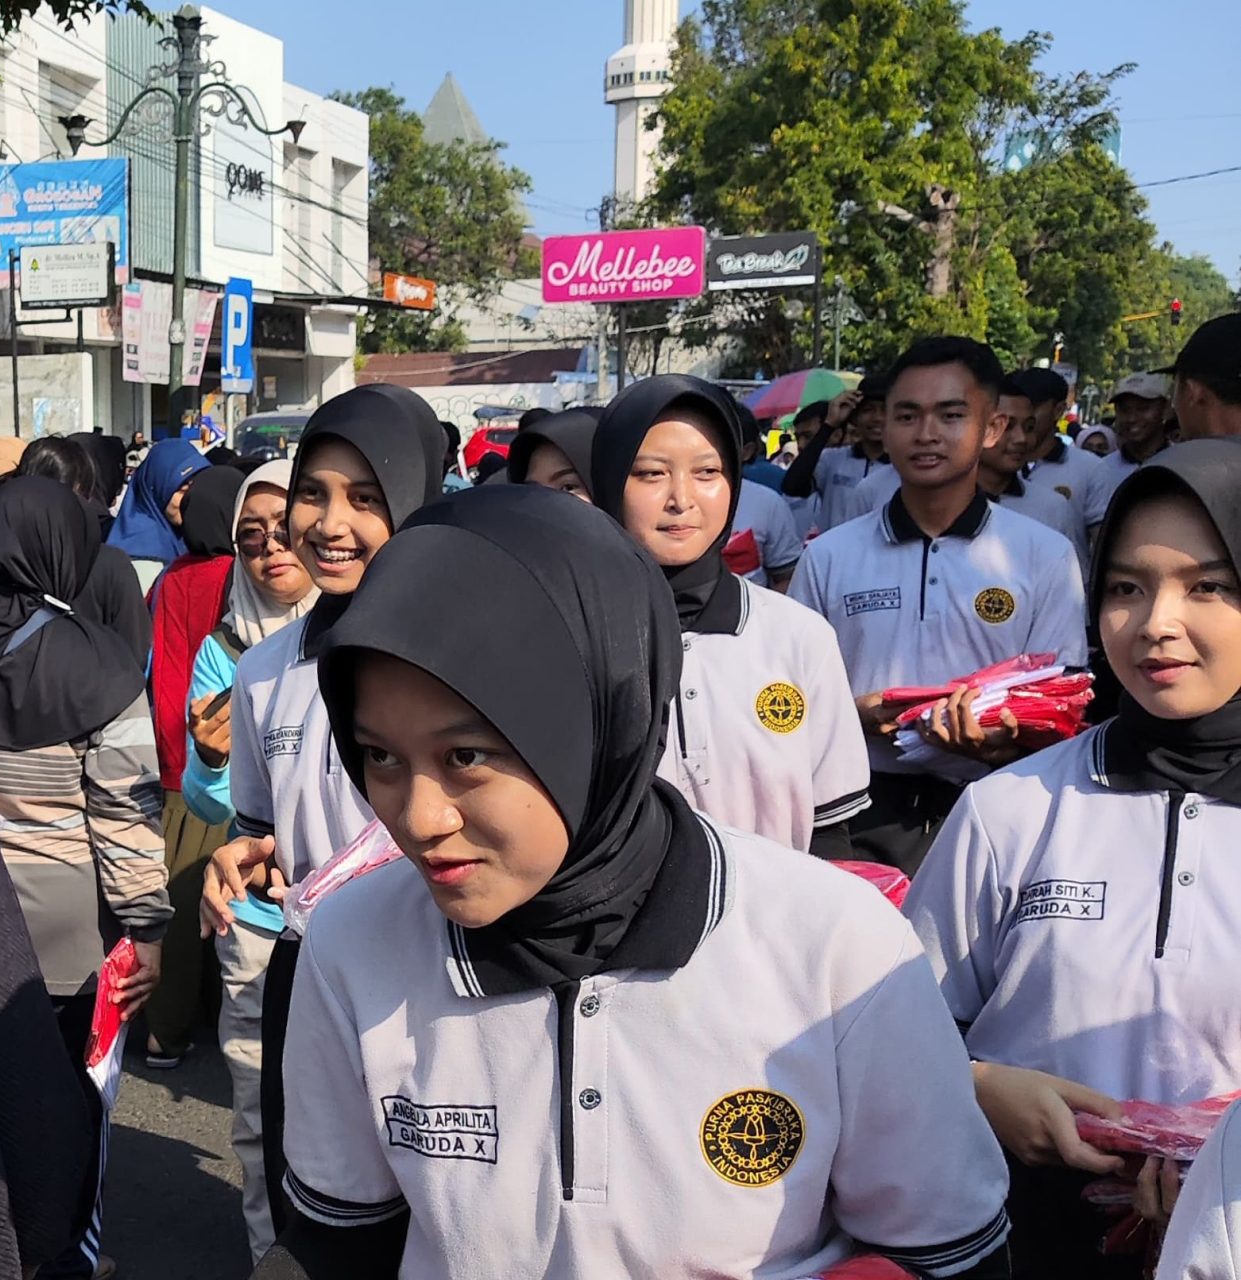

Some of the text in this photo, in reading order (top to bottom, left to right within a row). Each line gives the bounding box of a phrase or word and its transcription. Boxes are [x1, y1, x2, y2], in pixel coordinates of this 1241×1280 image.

[547, 240, 696, 286] Mellebee
[568, 277, 674, 297] BEAUTY SHOP
[226, 293, 249, 373] P
[1080, 904, 1091, 916] X
[435, 1111, 492, 1130] APRILITA
[705, 1092, 801, 1141] PURNA PASKIBRAKA
[400, 1127, 486, 1156] GARUDA X
[712, 1155, 793, 1184] INDONESIA
